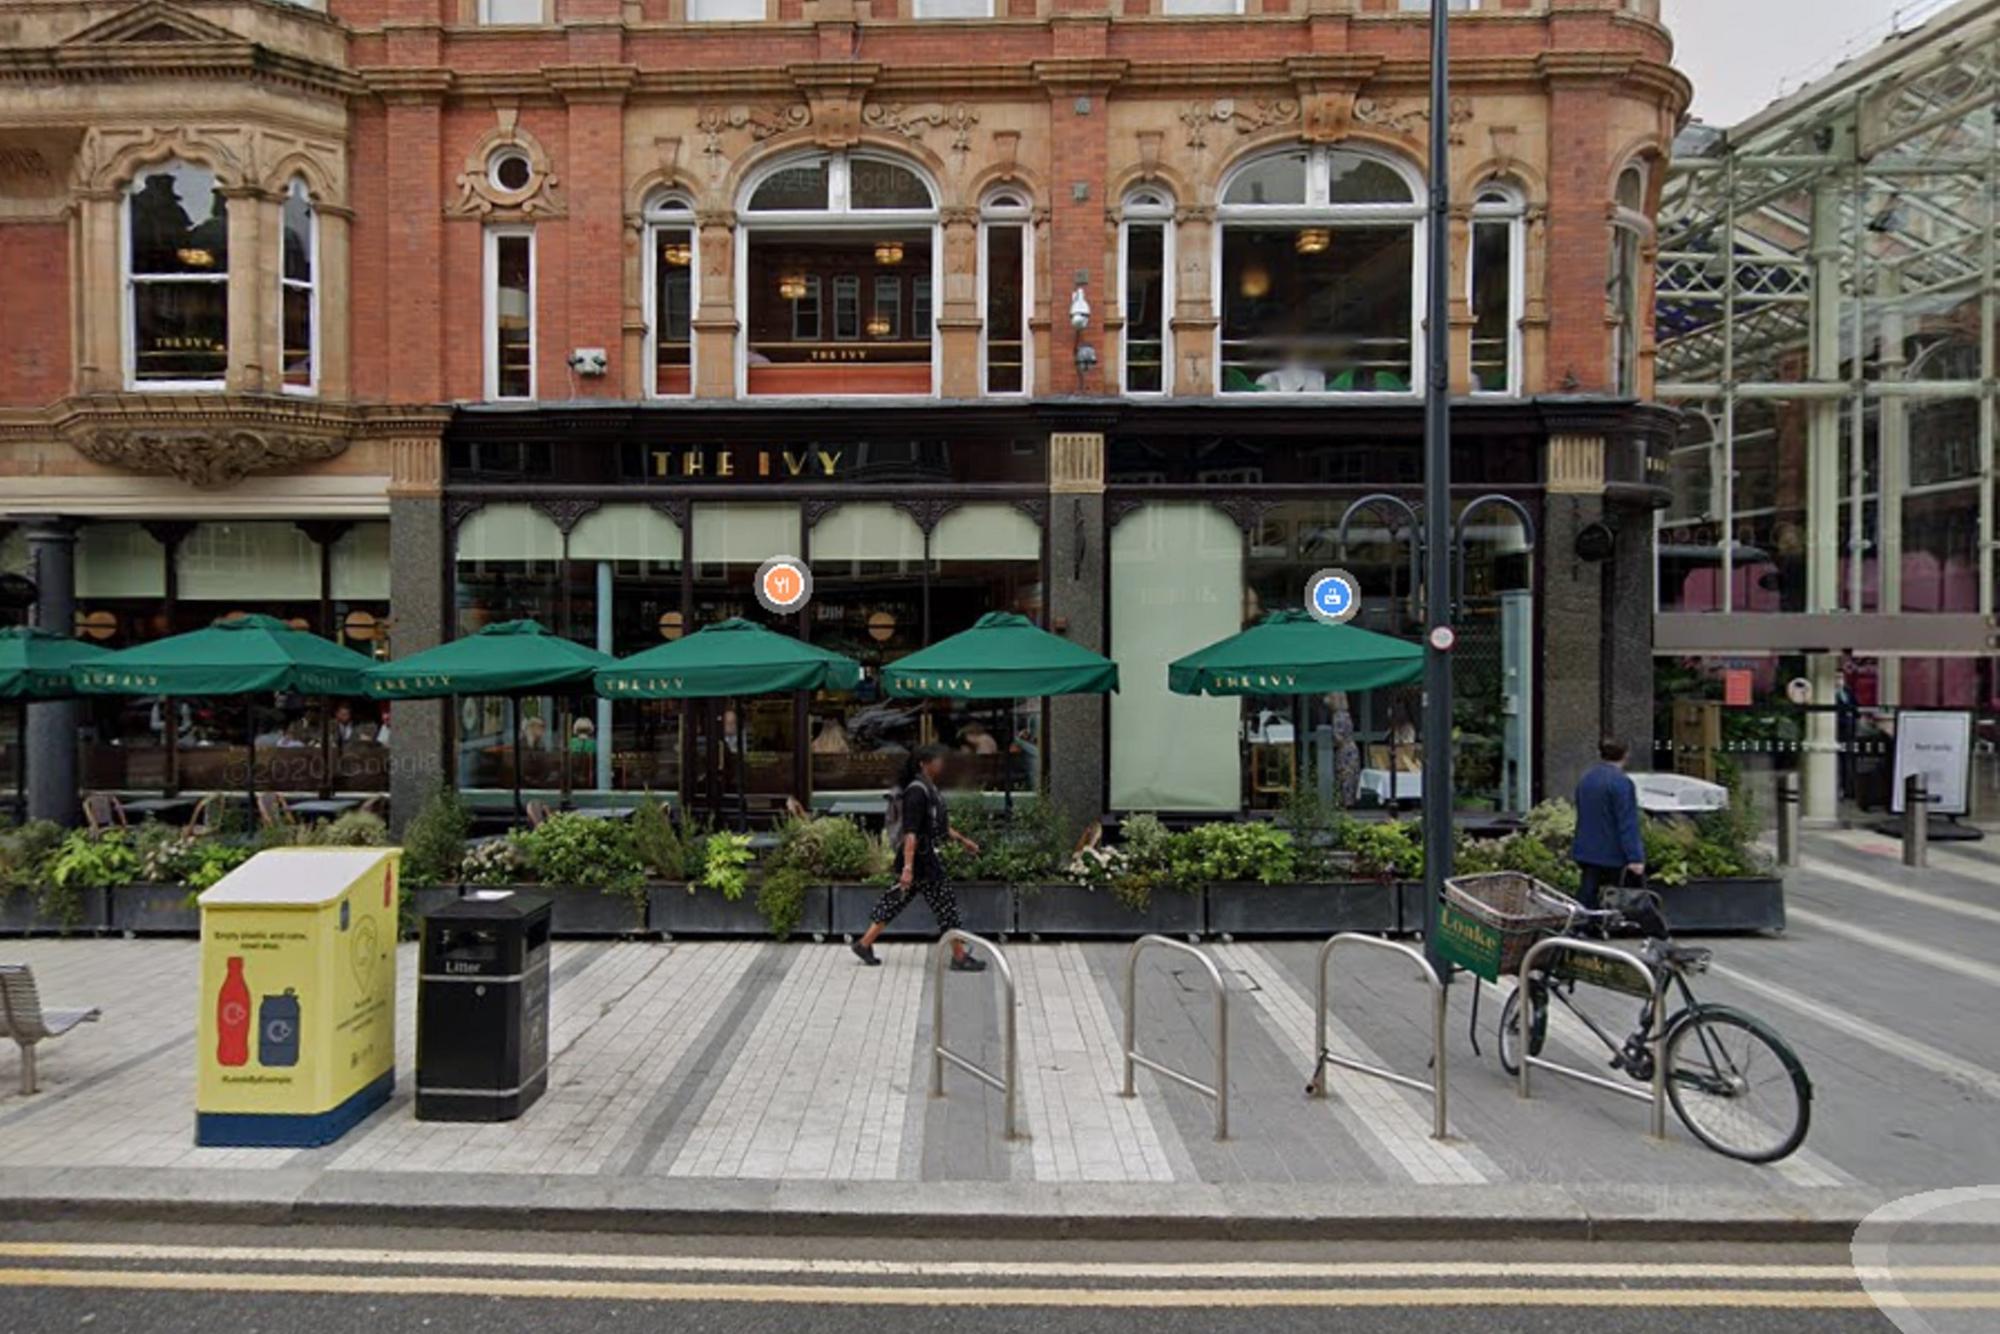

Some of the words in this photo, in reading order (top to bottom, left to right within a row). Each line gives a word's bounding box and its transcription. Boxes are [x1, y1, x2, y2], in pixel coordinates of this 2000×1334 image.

[811, 350, 837, 360] THE
[841, 350, 867, 360] IVY
[652, 452, 734, 475] THE
[759, 452, 842, 475] IVY
[374, 678, 407, 691] THE
[415, 676, 450, 688] IVY
[604, 679, 639, 690] THE
[648, 677, 684, 690] IVY
[895, 678, 928, 690] THE
[937, 678, 973, 690] IVY
[1215, 677, 1250, 688] THE
[1259, 675, 1297, 687] IVY
[445, 961, 482, 973] Litter
